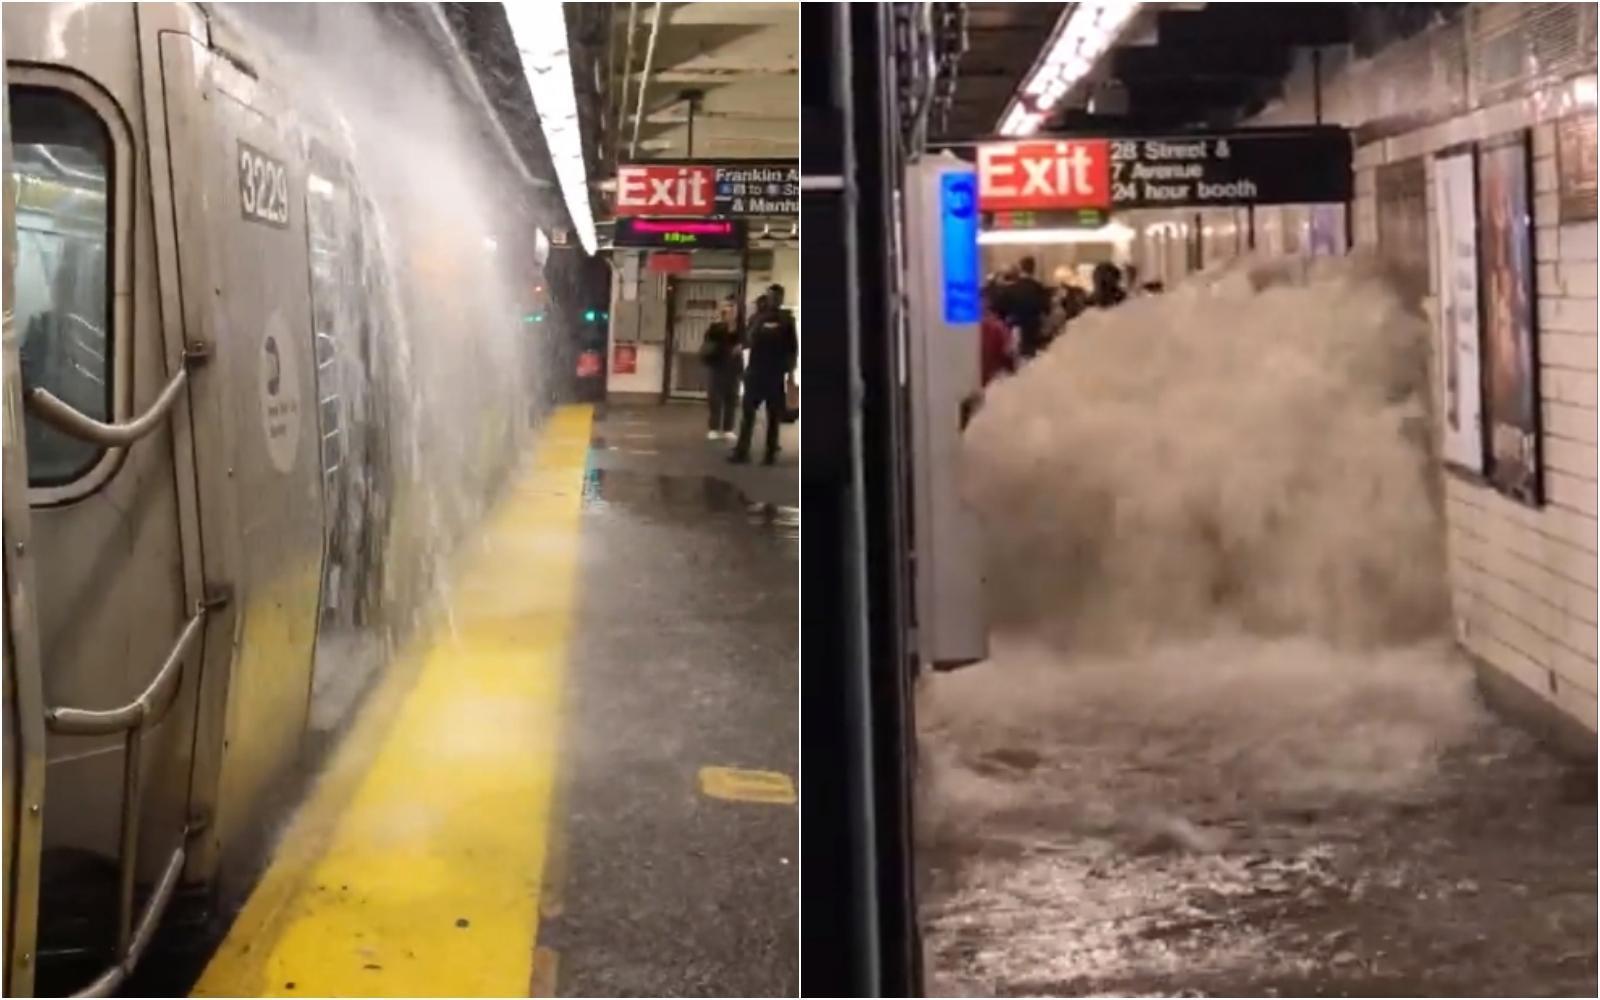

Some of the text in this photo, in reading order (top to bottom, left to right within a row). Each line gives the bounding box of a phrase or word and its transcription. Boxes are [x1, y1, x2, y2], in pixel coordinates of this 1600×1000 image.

[1110, 139, 1230, 160] 28 Street &
[716, 168, 782, 181] Franklin
[977, 143, 1094, 197] Exit
[1110, 163, 1203, 180] 7 Avenue
[241, 151, 289, 223] 3229
[618, 168, 707, 206] Exit
[1111, 178, 1257, 200] 24 hour booth
[732, 198, 744, 212] &
